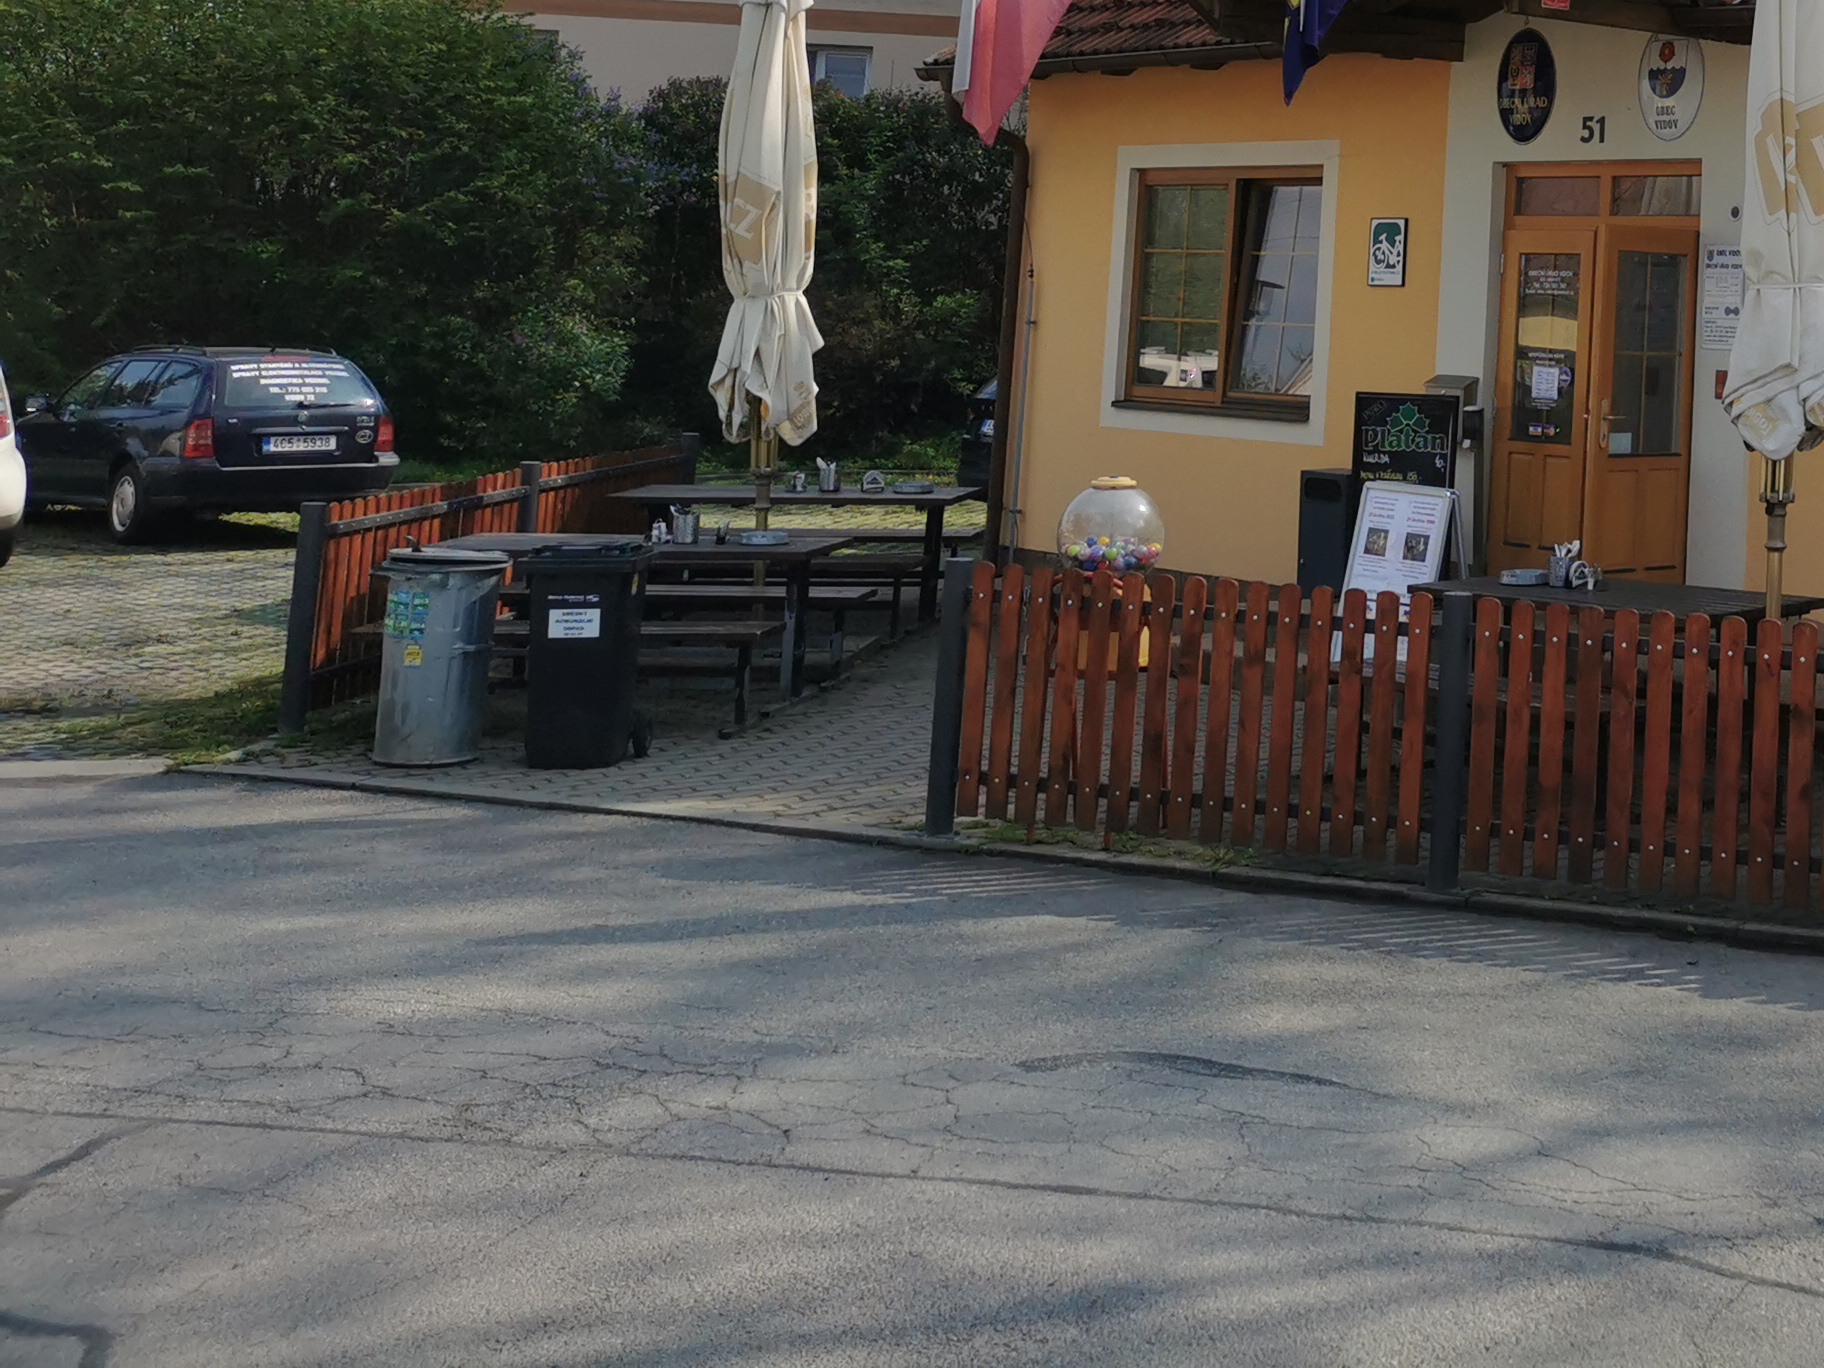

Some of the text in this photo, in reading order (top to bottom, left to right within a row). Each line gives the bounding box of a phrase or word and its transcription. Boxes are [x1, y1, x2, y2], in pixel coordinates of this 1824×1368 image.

[1655, 105, 1676, 117] OBEC
[1579, 116, 1606, 144] 51
[1654, 119, 1679, 130] VIDOV
[273, 436, 331, 449] 4C5 5938
[1361, 426, 1449, 453] Platan
